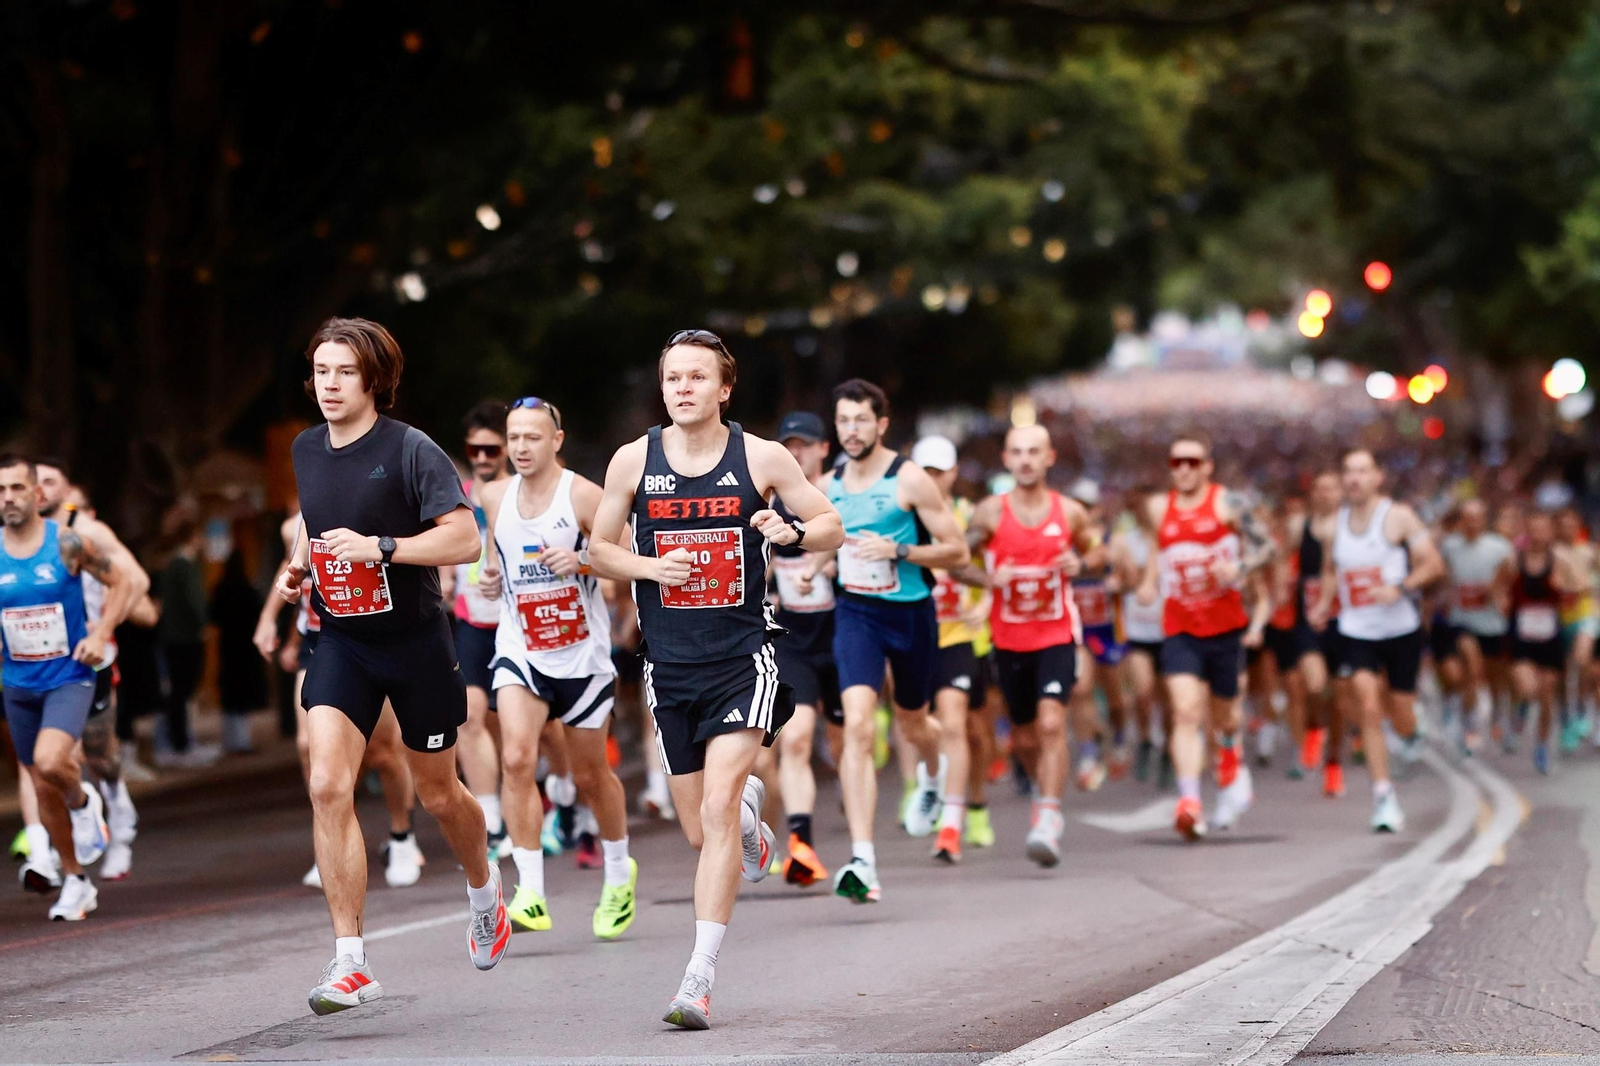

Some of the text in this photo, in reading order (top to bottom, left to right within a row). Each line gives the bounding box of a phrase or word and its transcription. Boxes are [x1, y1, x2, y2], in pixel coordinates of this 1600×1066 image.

[645, 474, 676, 491] BRC
[648, 496, 741, 519] BETTER
[675, 532, 728, 544] GENERALI
[325, 561, 352, 574] 523
[534, 604, 559, 618] 475
